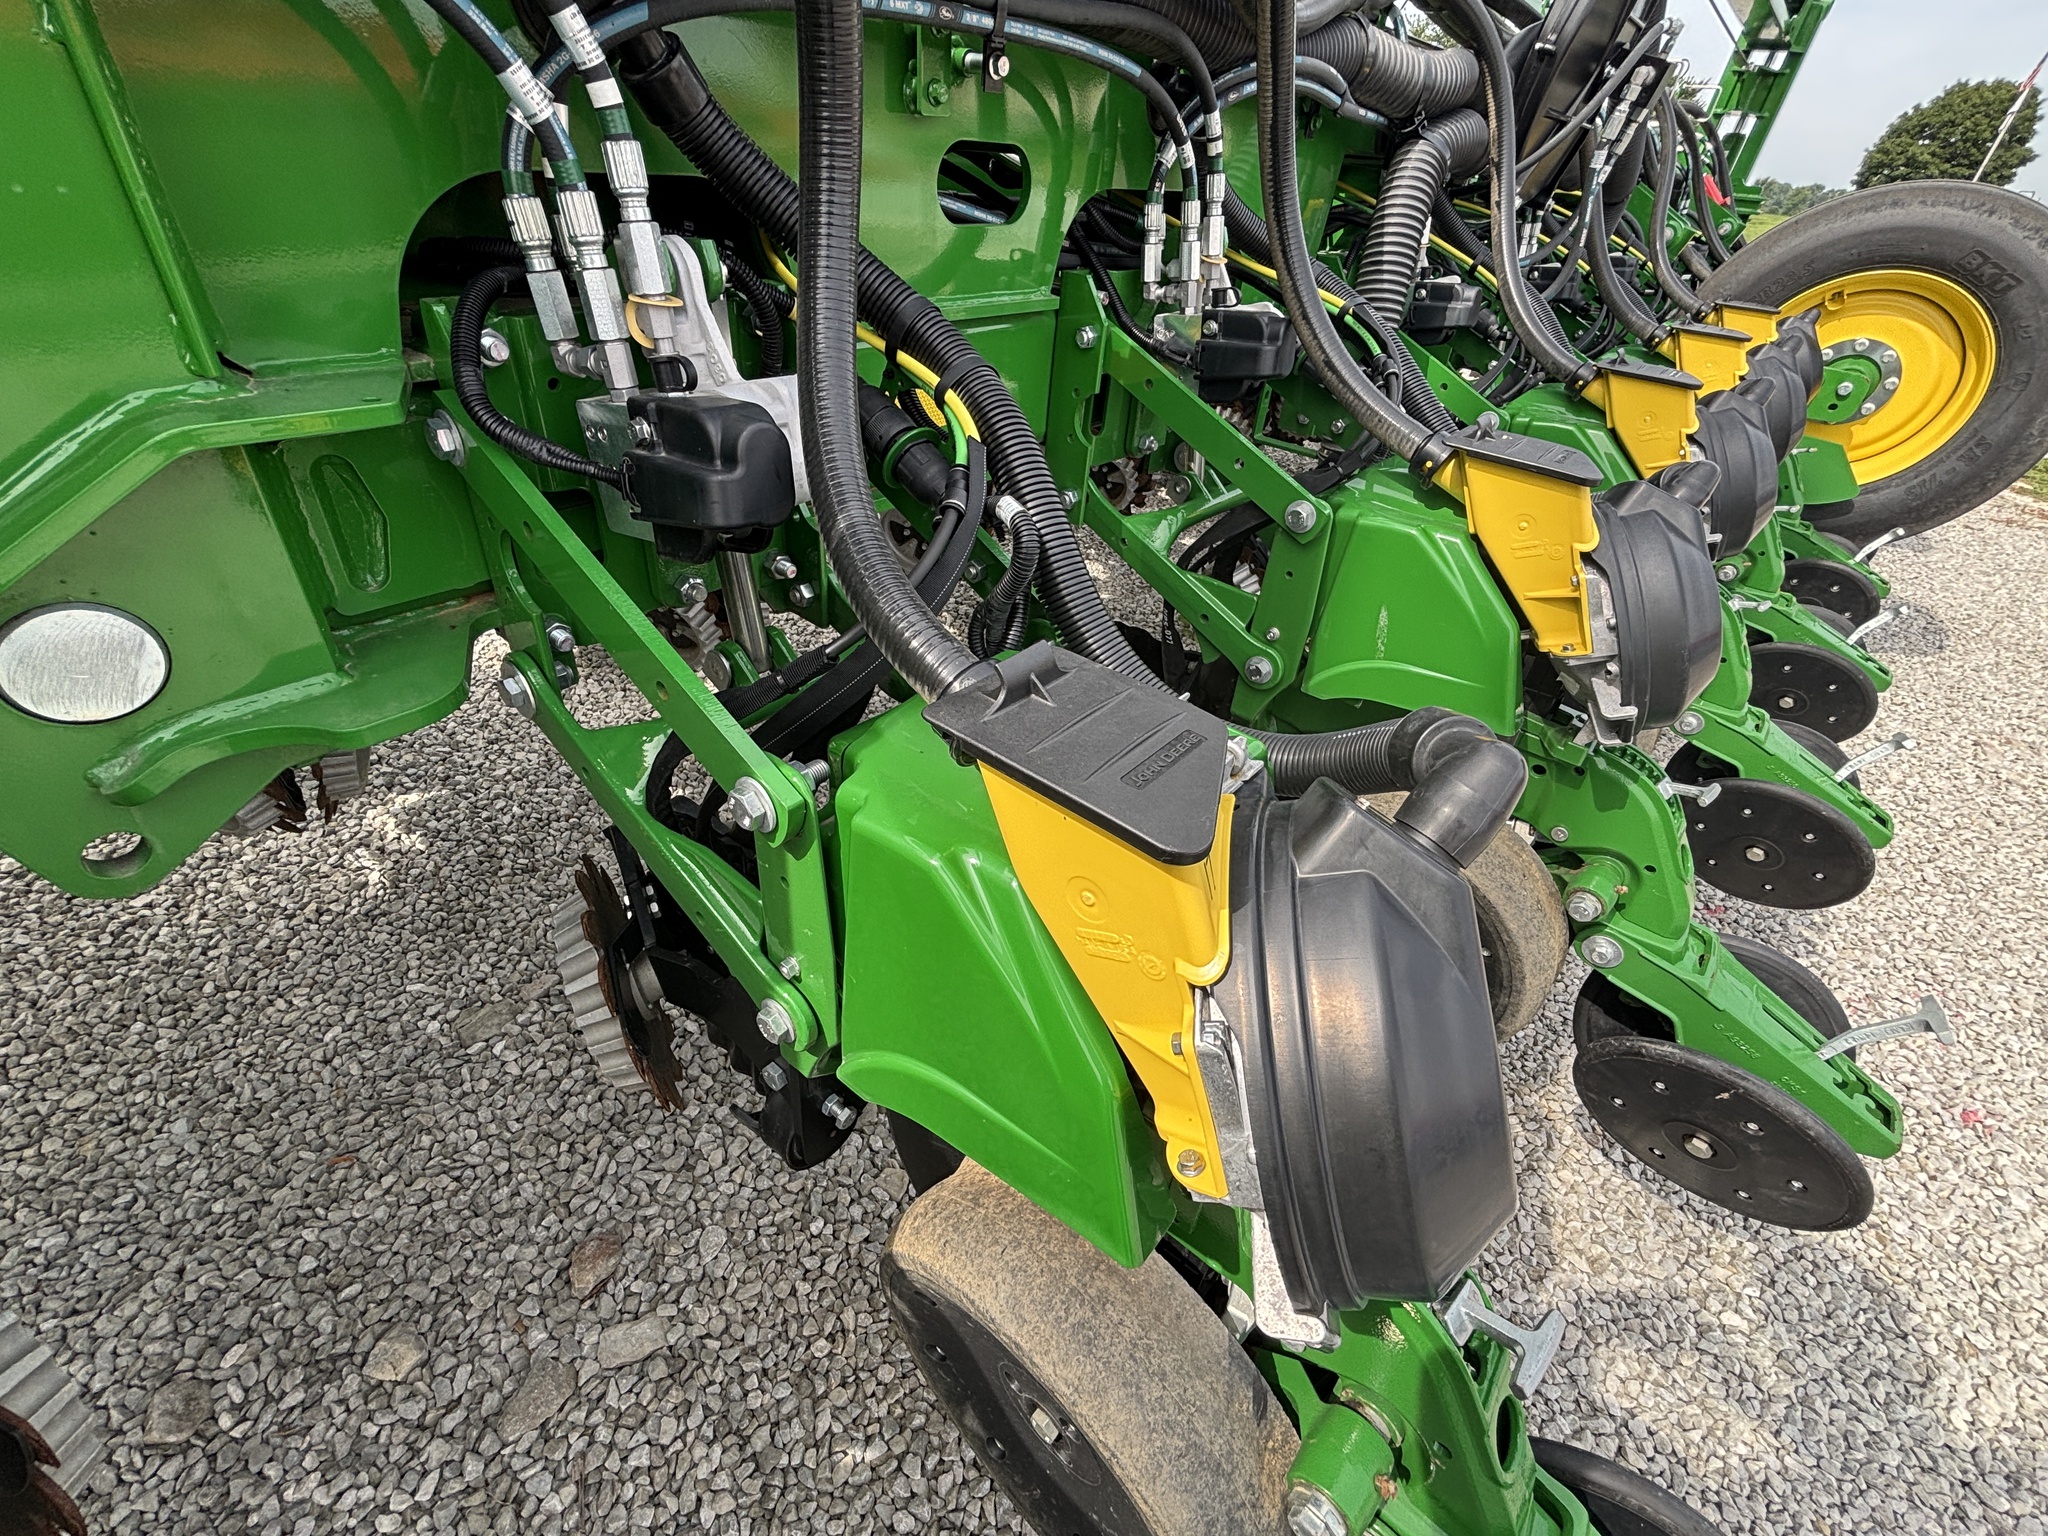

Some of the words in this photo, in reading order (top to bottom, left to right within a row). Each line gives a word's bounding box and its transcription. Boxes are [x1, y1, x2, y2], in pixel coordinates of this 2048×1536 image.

[1962, 252, 2017, 297] BKT
[1131, 759, 1165, 788] JOHN
[1161, 733, 1203, 763] DEERE
